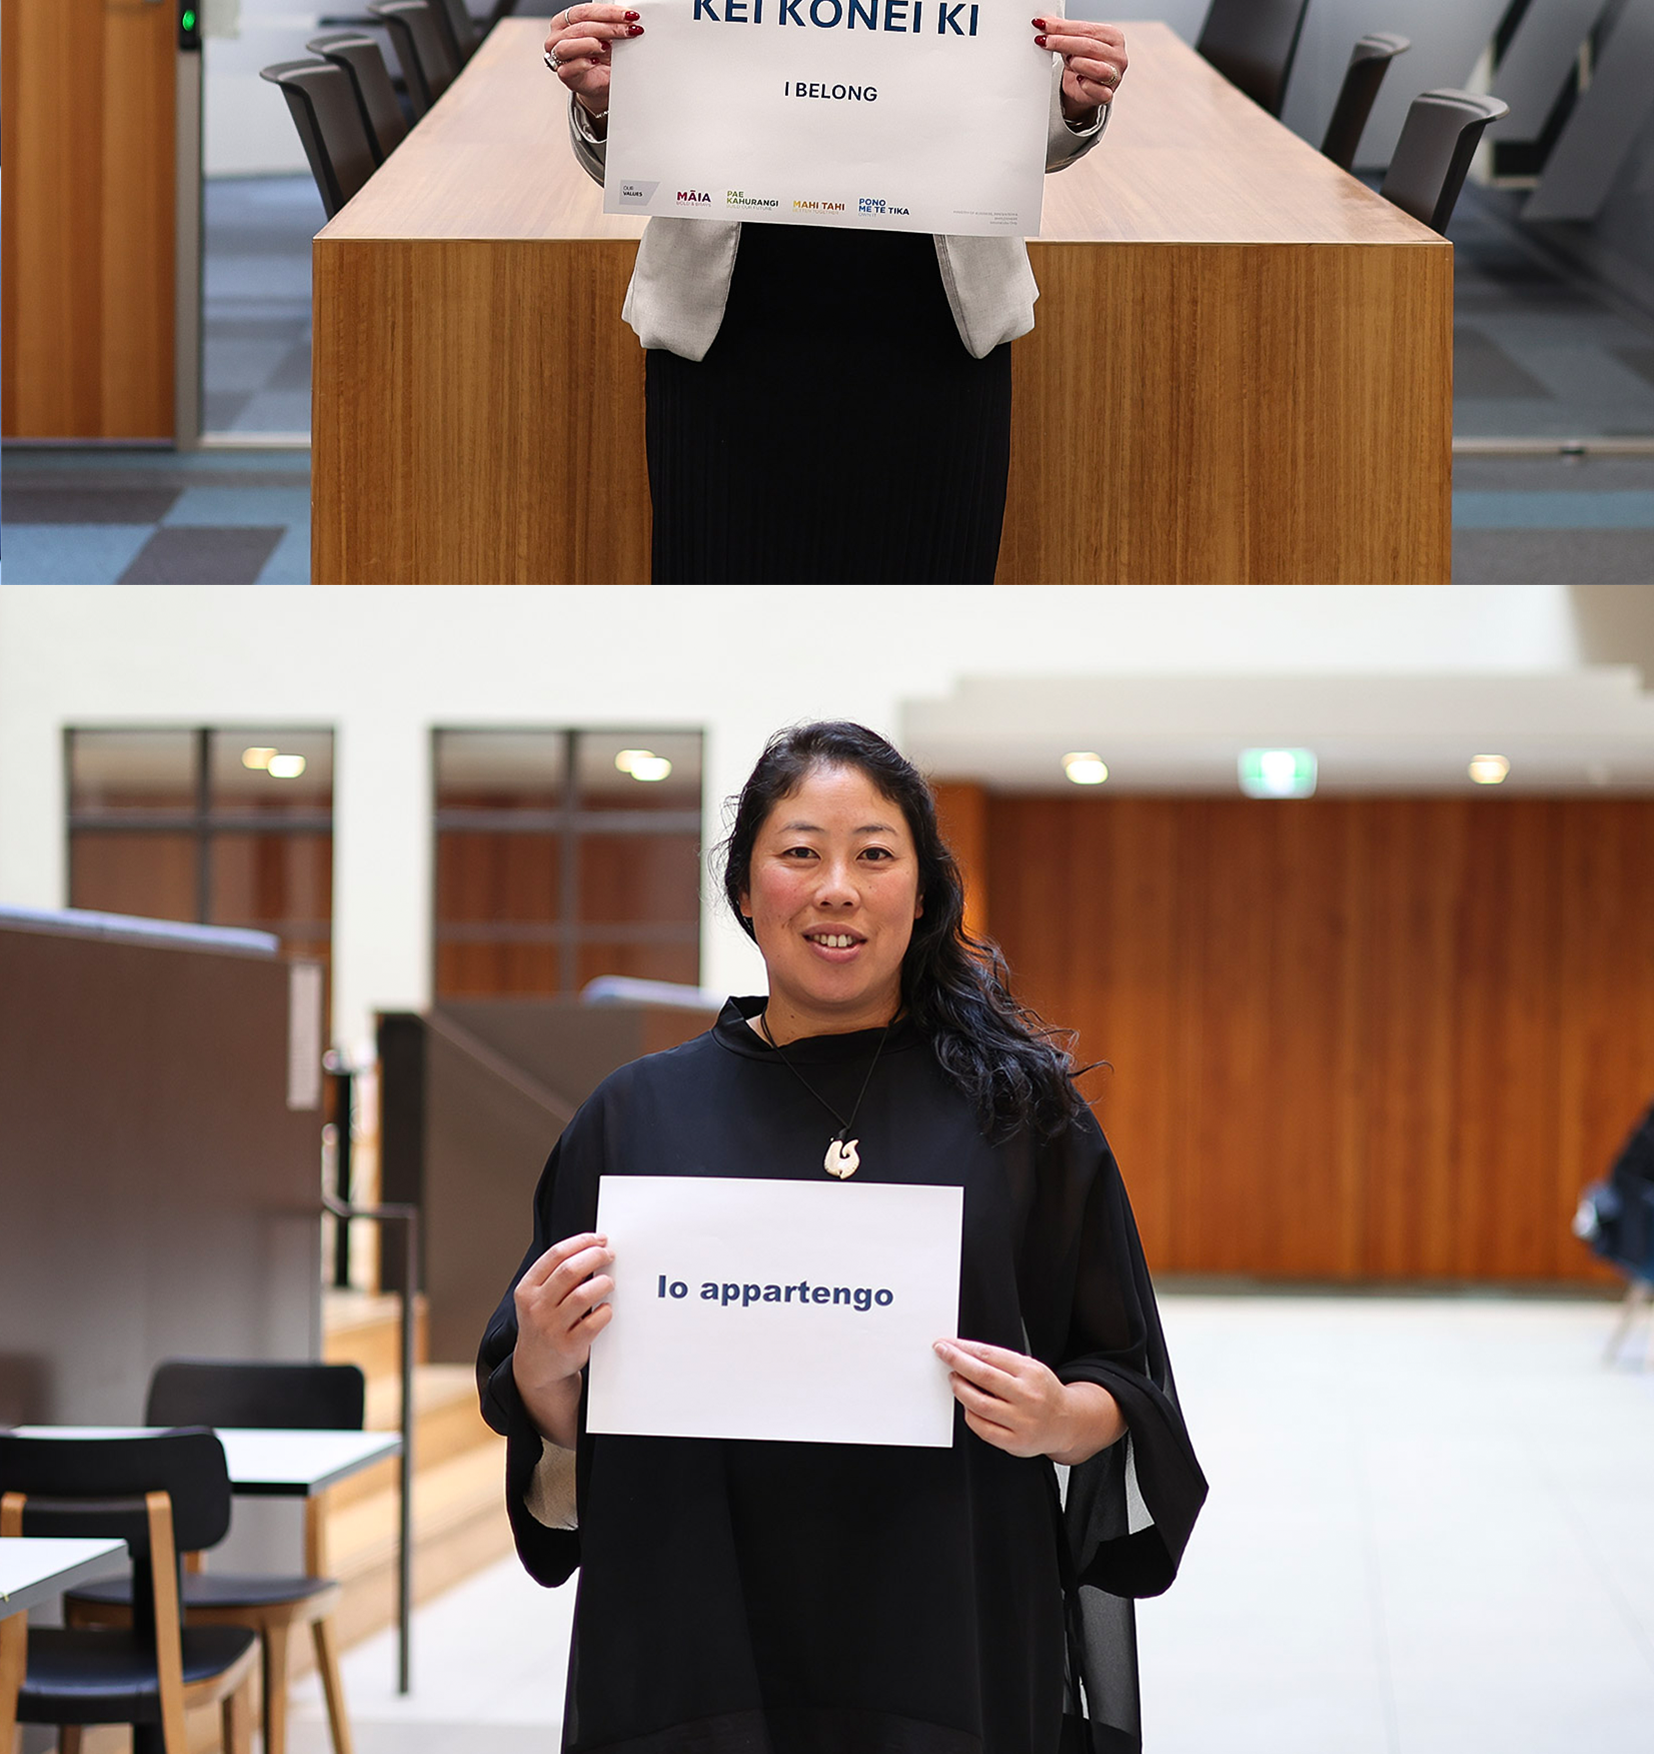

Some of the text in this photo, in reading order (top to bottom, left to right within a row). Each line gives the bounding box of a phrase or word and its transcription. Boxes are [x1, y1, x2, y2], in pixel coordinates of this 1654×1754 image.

[937, 2, 979, 37] KI
[784, 81, 878, 102] I BELONG
[677, 190, 711, 202] MĀIA
[727, 190, 744, 198] PAE
[727, 197, 779, 207] KAHURANGI
[793, 200, 845, 211] MAHI TAHI
[859, 198, 886, 206] PONO
[859, 205, 872, 213] ME
[888, 207, 910, 215] TIKA
[657, 1274, 894, 1312] Io appartengo
